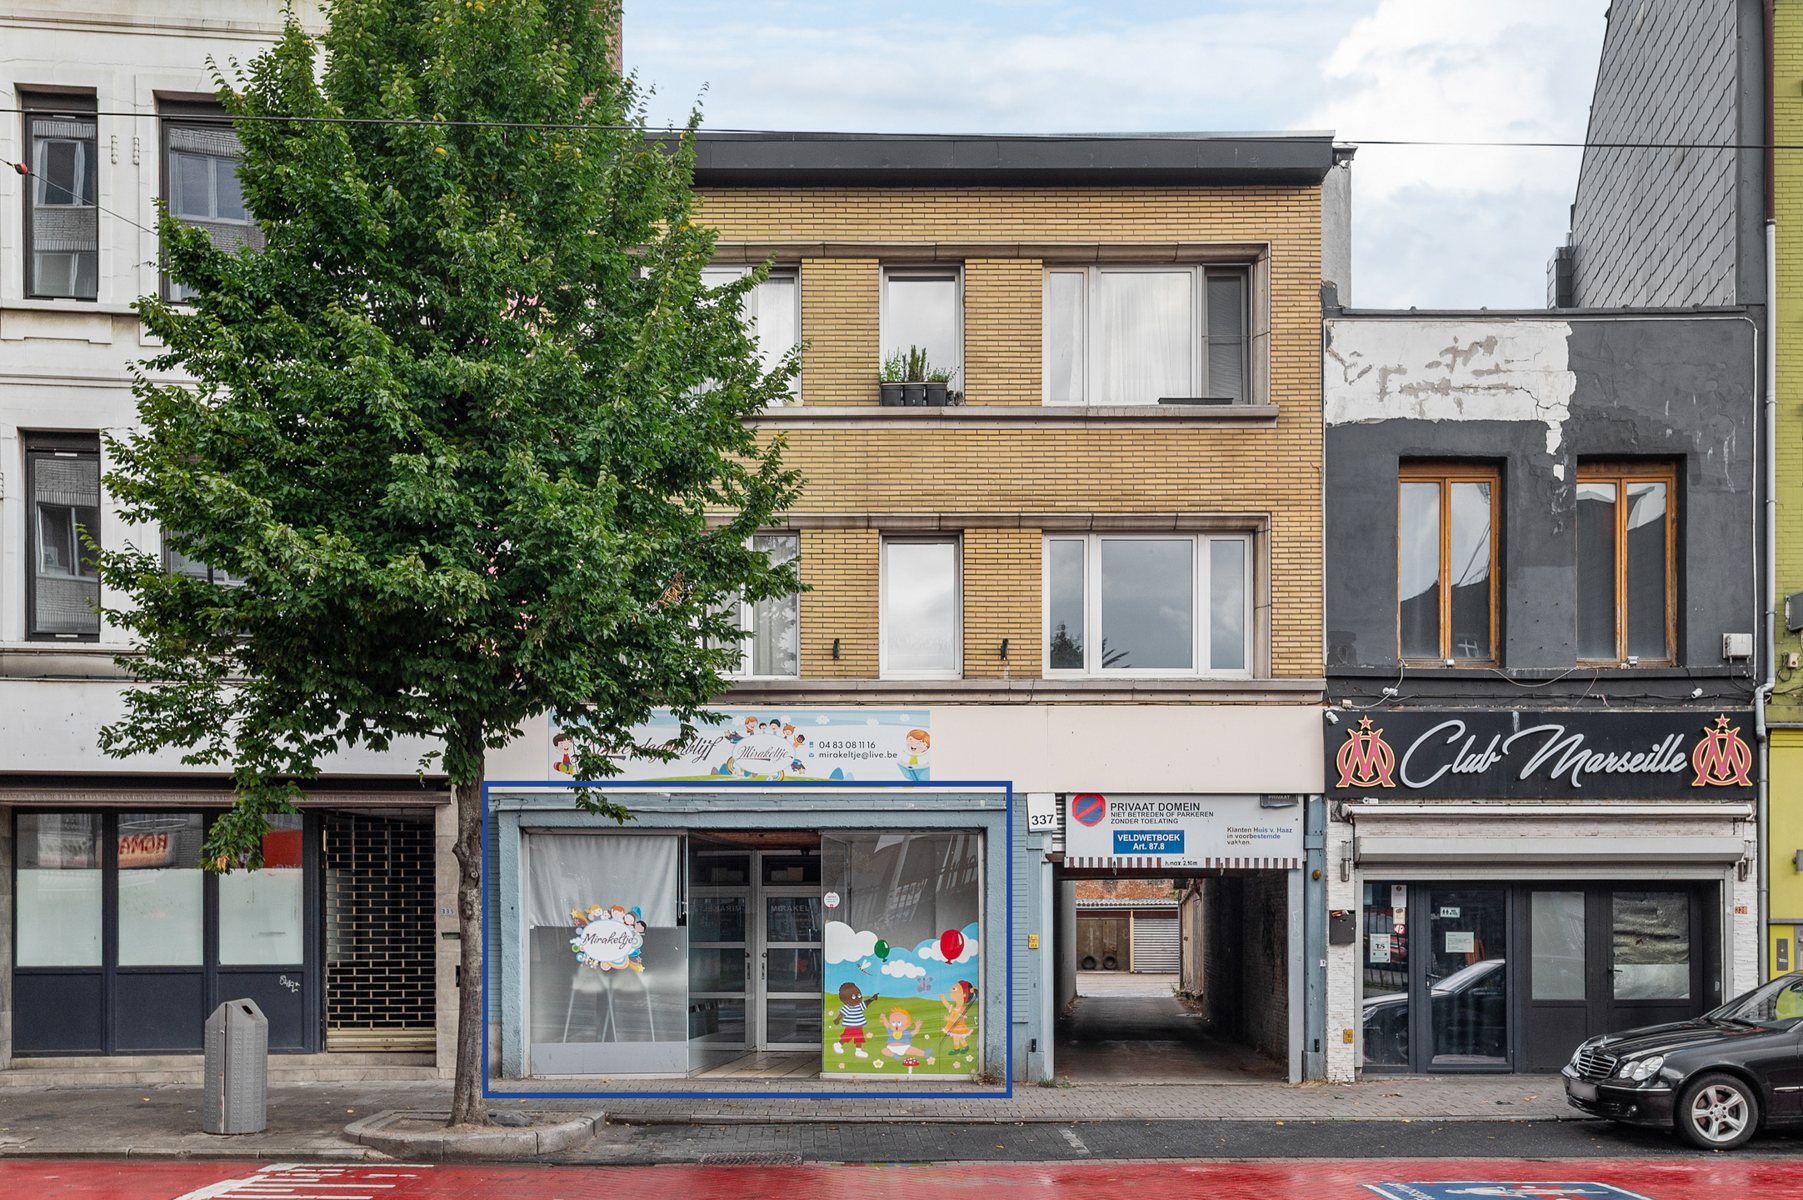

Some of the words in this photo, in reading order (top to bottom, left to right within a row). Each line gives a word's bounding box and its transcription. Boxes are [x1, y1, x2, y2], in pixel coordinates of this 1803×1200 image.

[819, 741, 830, 749] 04
[832, 741, 843, 749] 83
[845, 741, 857, 749] 08
[859, 741, 865, 749] 11
[866, 741, 876, 749] 16
[736, 745, 794, 762] Mirakeltje
[819, 751, 898, 760] mirakeltje@live.be
[1399, 719, 1500, 788] Club
[1502, 724, 1688, 788] Marseille
[1110, 803, 1155, 811] PRIVAAT
[1158, 803, 1200, 811] DOMEIN
[1031, 814, 1055, 826] 337
[582, 931, 634, 950] Mirakeltje
